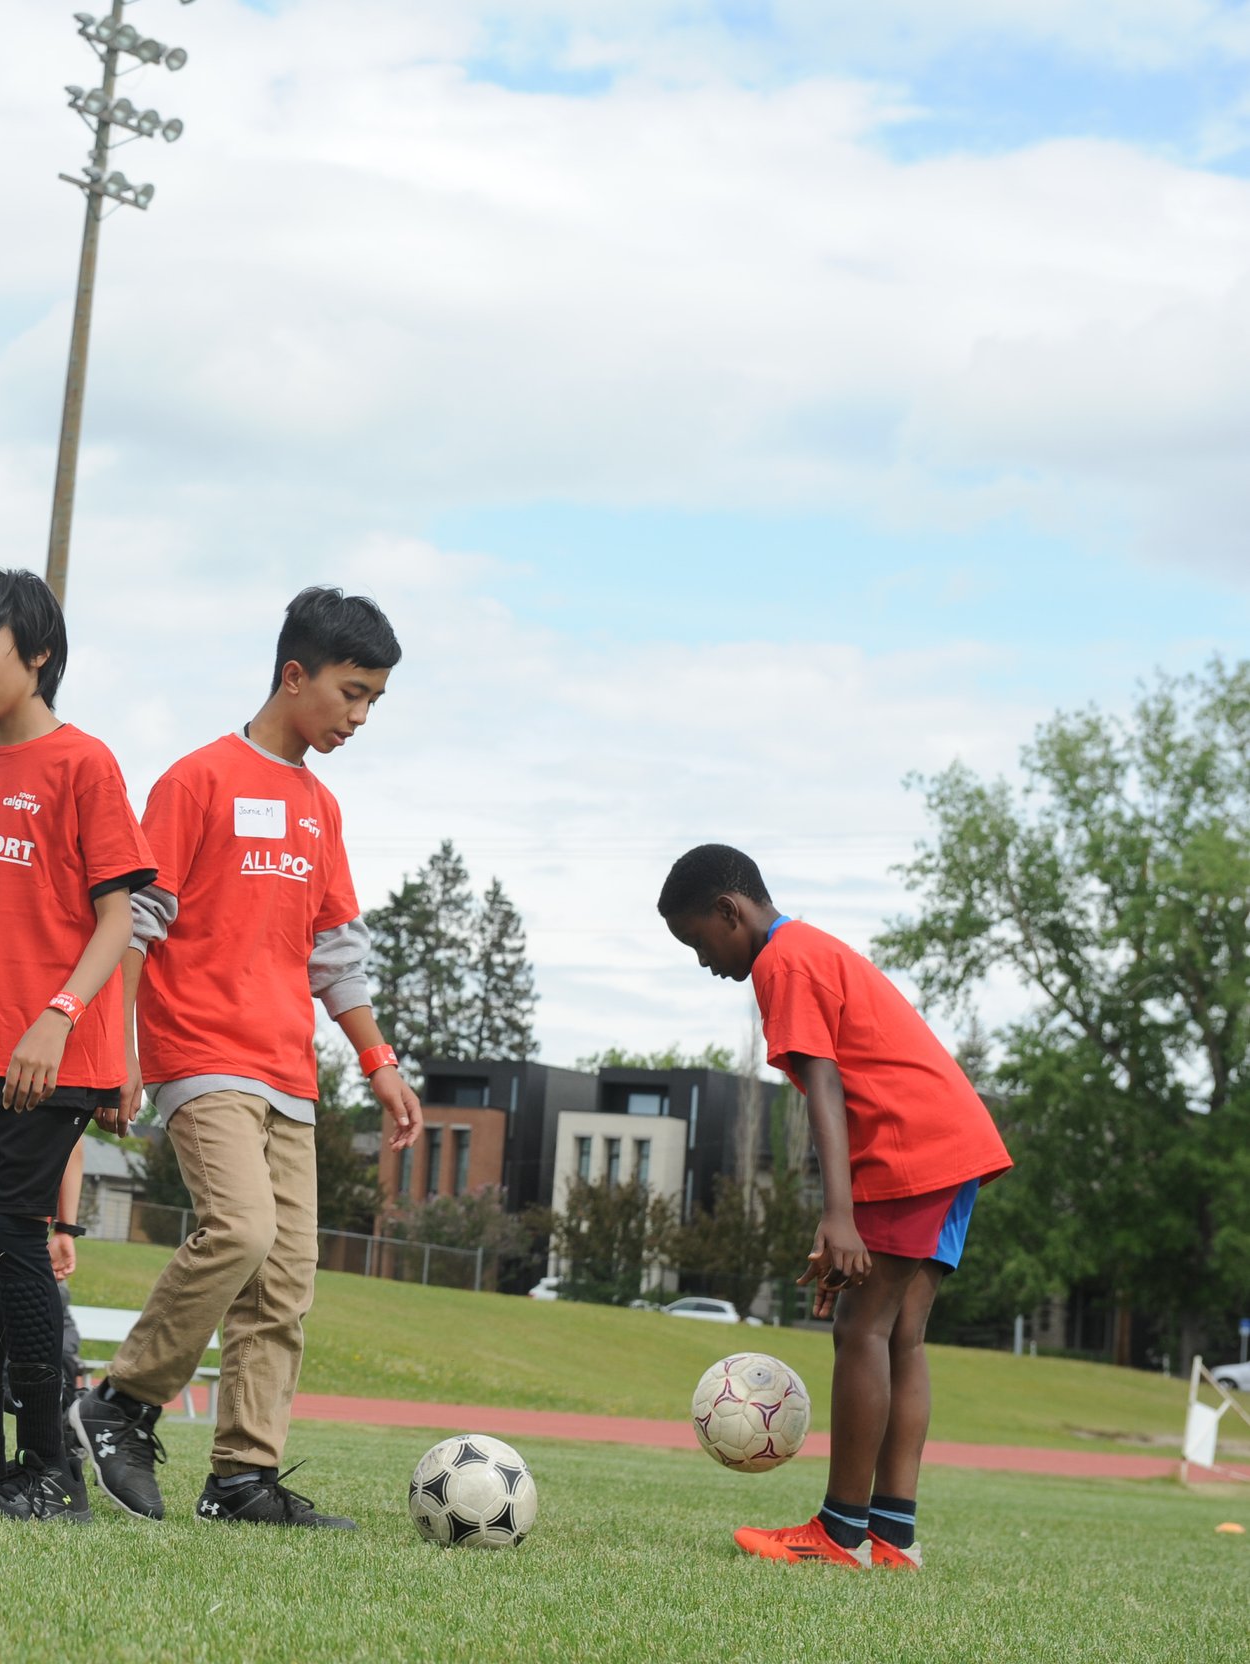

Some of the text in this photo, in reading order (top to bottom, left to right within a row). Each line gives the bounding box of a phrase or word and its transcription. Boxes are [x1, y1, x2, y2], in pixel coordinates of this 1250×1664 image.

[2, 795, 42, 815] calgary
[18, 791, 36, 801] sport
[241, 851, 277, 869] ALL
